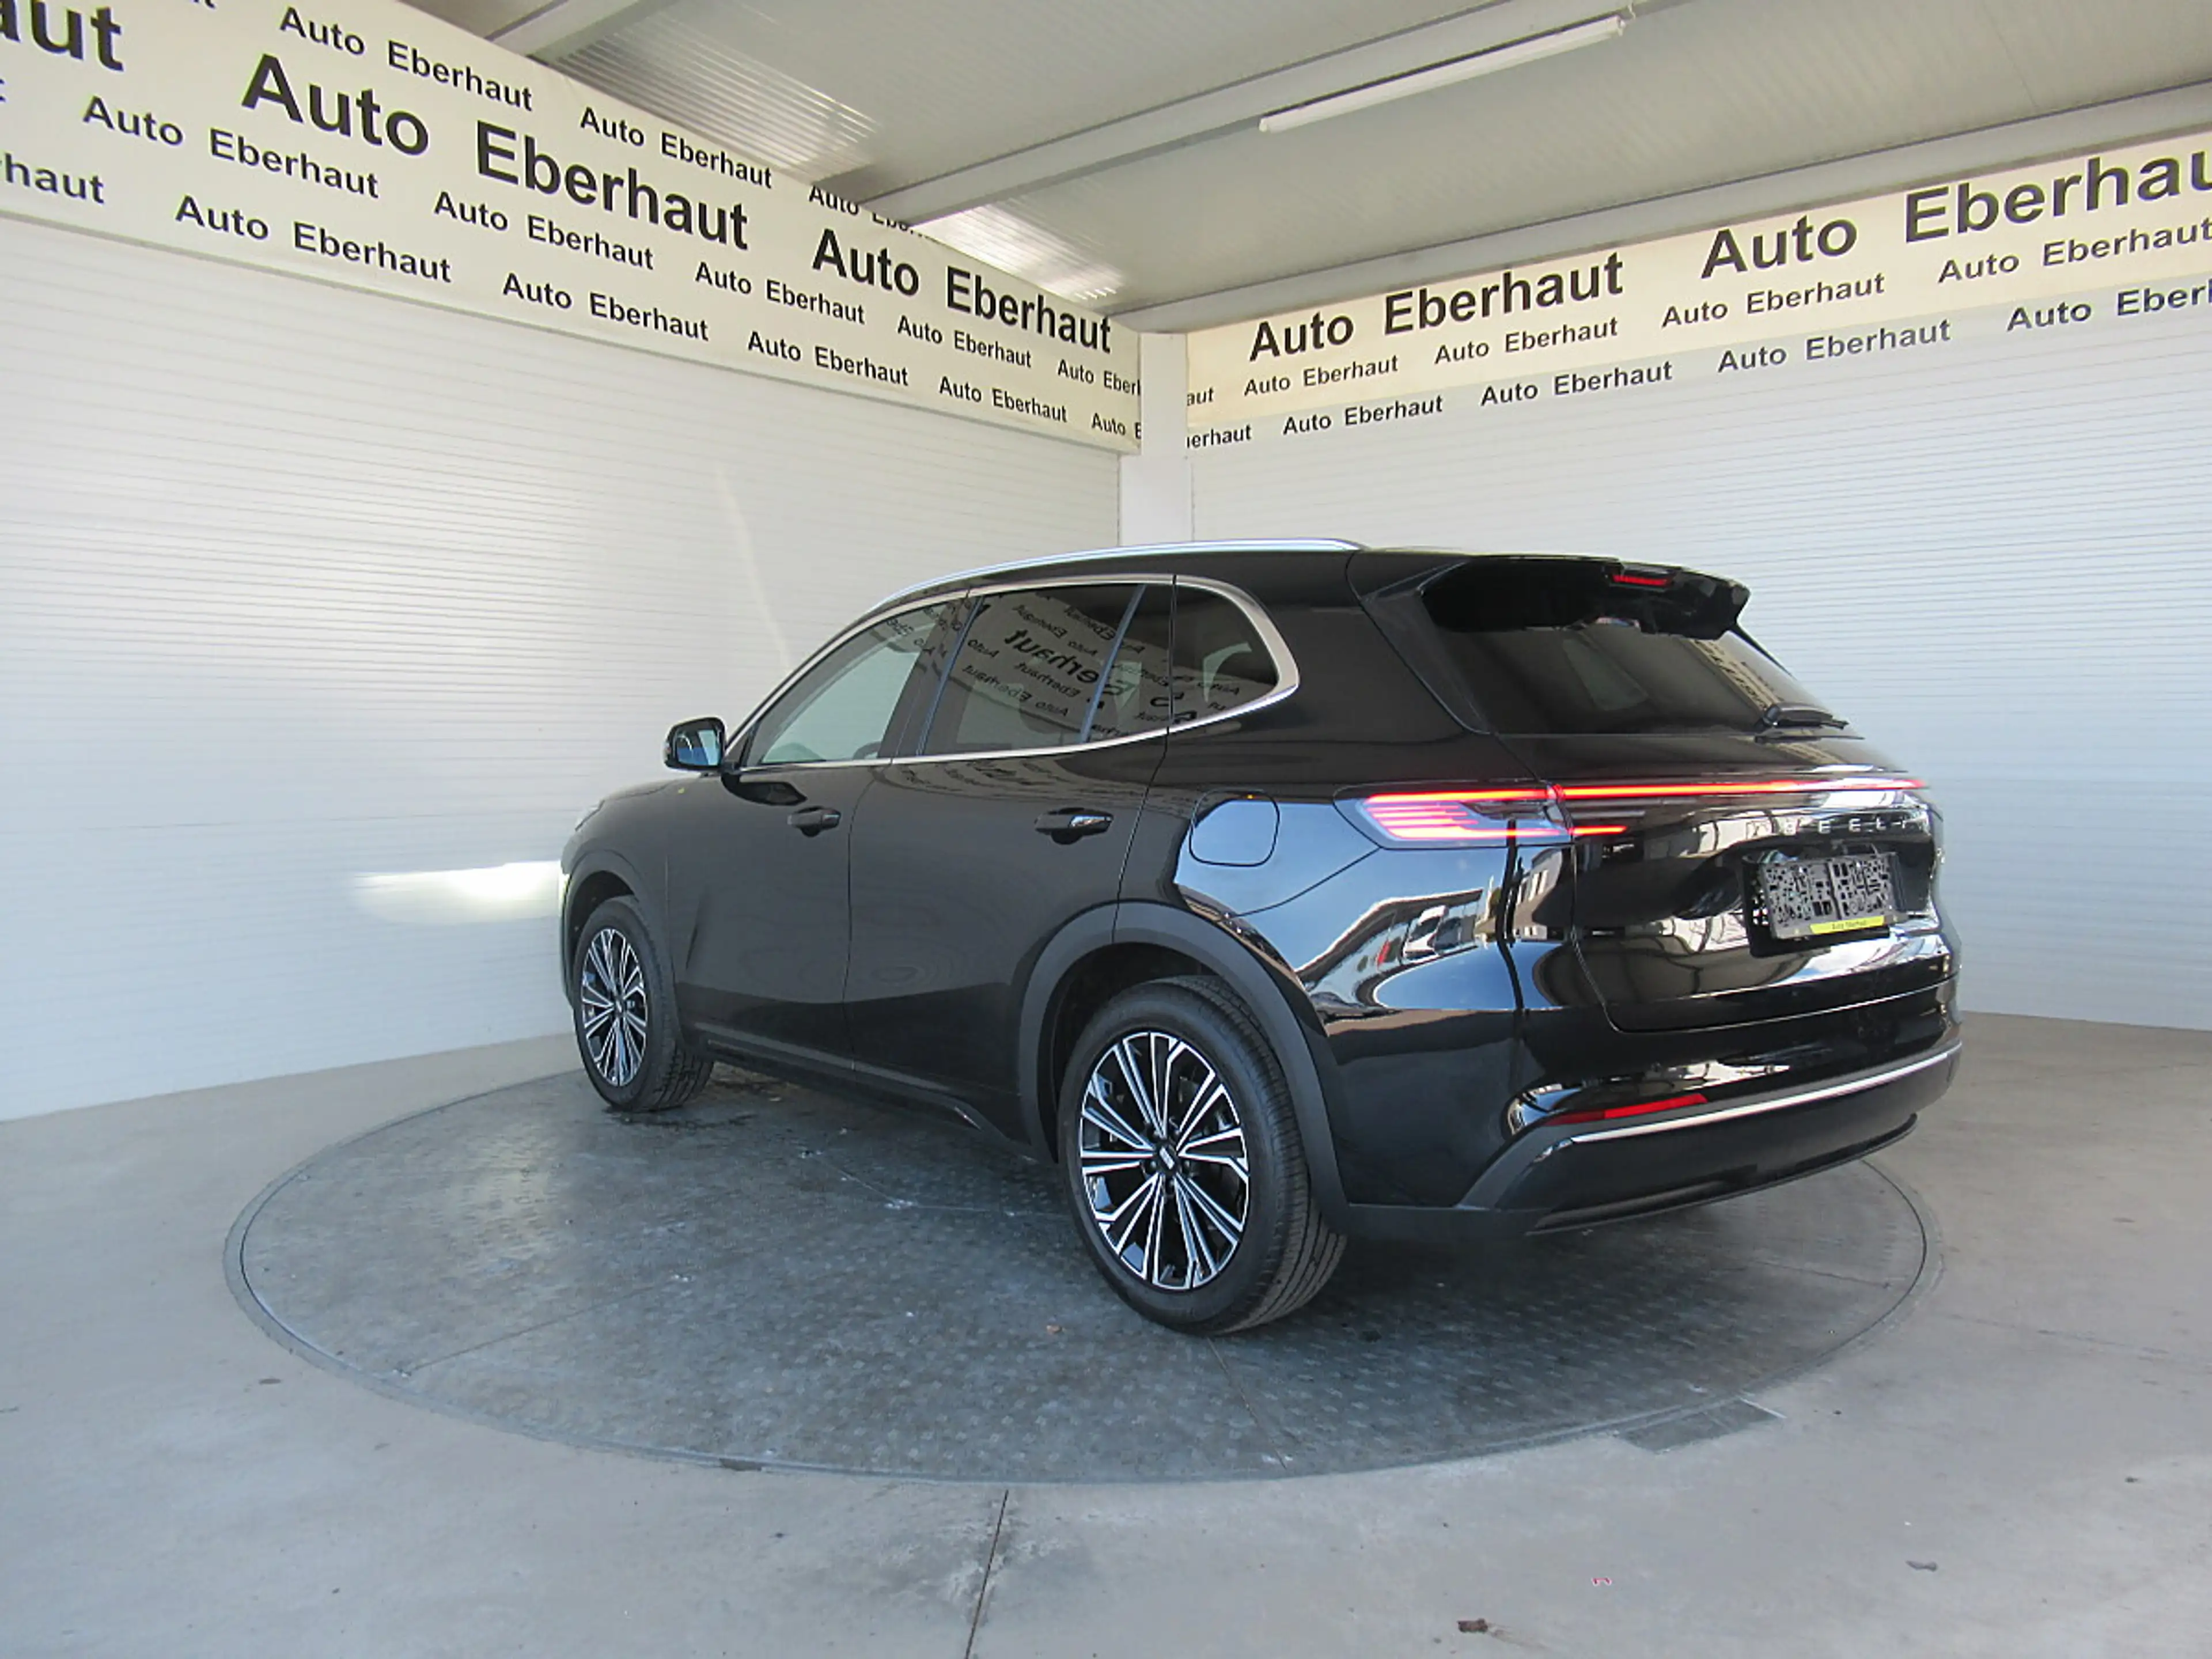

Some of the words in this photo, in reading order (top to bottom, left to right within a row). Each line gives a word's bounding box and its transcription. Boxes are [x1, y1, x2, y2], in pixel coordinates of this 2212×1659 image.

[280, 7, 365, 55] Auto
[389, 40, 532, 112] Eberhaut
[83, 96, 183, 145] Auto
[210, 128, 378, 199] Eberhaut
[241, 54, 428, 156] Auto
[477, 120, 748, 251] Eberhaut
[581, 107, 644, 146] Auto
[662, 132, 771, 189] Eberhaut
[0, 153, 104, 204] haut
[809, 185, 859, 215] Auto
[175, 196, 268, 240] Auto
[294, 221, 451, 283] Eberhaut
[434, 191, 507, 231] Auto
[528, 214, 653, 270] Eberhaut
[1701, 215, 1857, 279] Auto
[695, 262, 752, 294] Auto
[767, 279, 865, 325] Eberhaut
[812, 228, 919, 297] Auto
[948, 266, 1112, 354] Eberhaut
[1938, 254, 2019, 283] Auto
[503, 272, 572, 309] Auto
[590, 291, 709, 342] Eberhaut
[1249, 312, 1354, 362] Auto
[1385, 252, 1623, 335] Eberhaut
[1662, 302, 1728, 328] Auto
[1747, 273, 1884, 314] Eberhaut
[2008, 302, 2091, 331] Auto
[2118, 278, 2212, 316] Eber
[748, 331, 801, 361] Auto
[815, 346, 908, 386] Eberhaut
[897, 315, 942, 344] Auto
[954, 329, 1031, 369] Eberhaut
[1434, 341, 1489, 364] Auto
[1505, 317, 1618, 353] Eberhaut
[1718, 346, 1786, 373] Auto
[1806, 319, 1950, 359] Eberhaut
[1058, 358, 1094, 384] Auto
[1244, 376, 1290, 396] Auto
[1304, 355, 1397, 387] Eberhaut
[1481, 383, 1538, 406] Auto
[1554, 361, 1672, 395] Eberhaut
[940, 376, 982, 402] Auto
[992, 387, 1067, 423] Eberhaut
[1092, 412, 1126, 435] Auto
[1283, 414, 1331, 435] Auto
[1344, 395, 1442, 426] Eberhaut
[1187, 424, 1251, 448] erhaut
